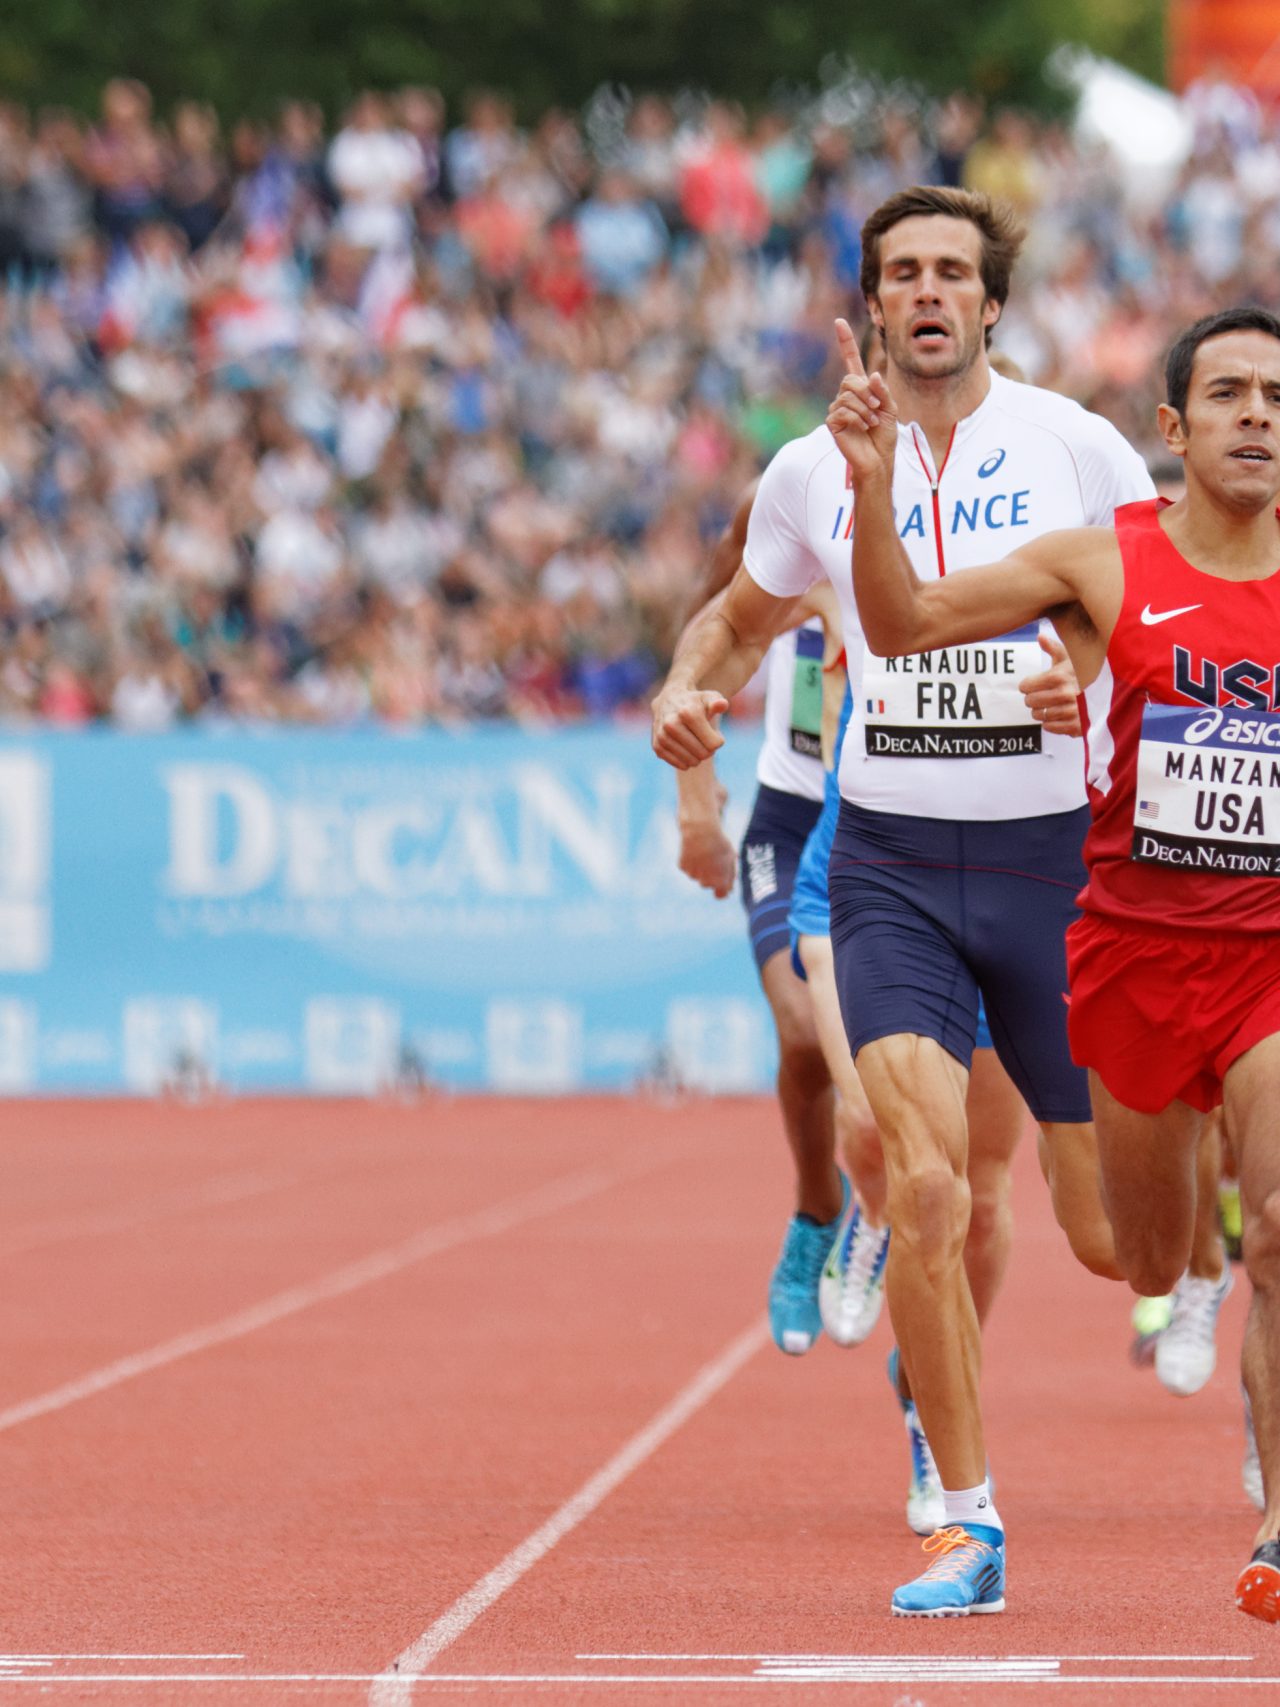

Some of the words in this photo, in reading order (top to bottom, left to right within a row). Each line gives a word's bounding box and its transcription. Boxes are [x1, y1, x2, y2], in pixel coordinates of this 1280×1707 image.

[849, 489, 1031, 539] ANCE
[886, 649, 1015, 674] RENAUDIE
[917, 682, 983, 719] FRA
[1000, 736, 1034, 753] 2014
[1194, 790, 1265, 836] USA
